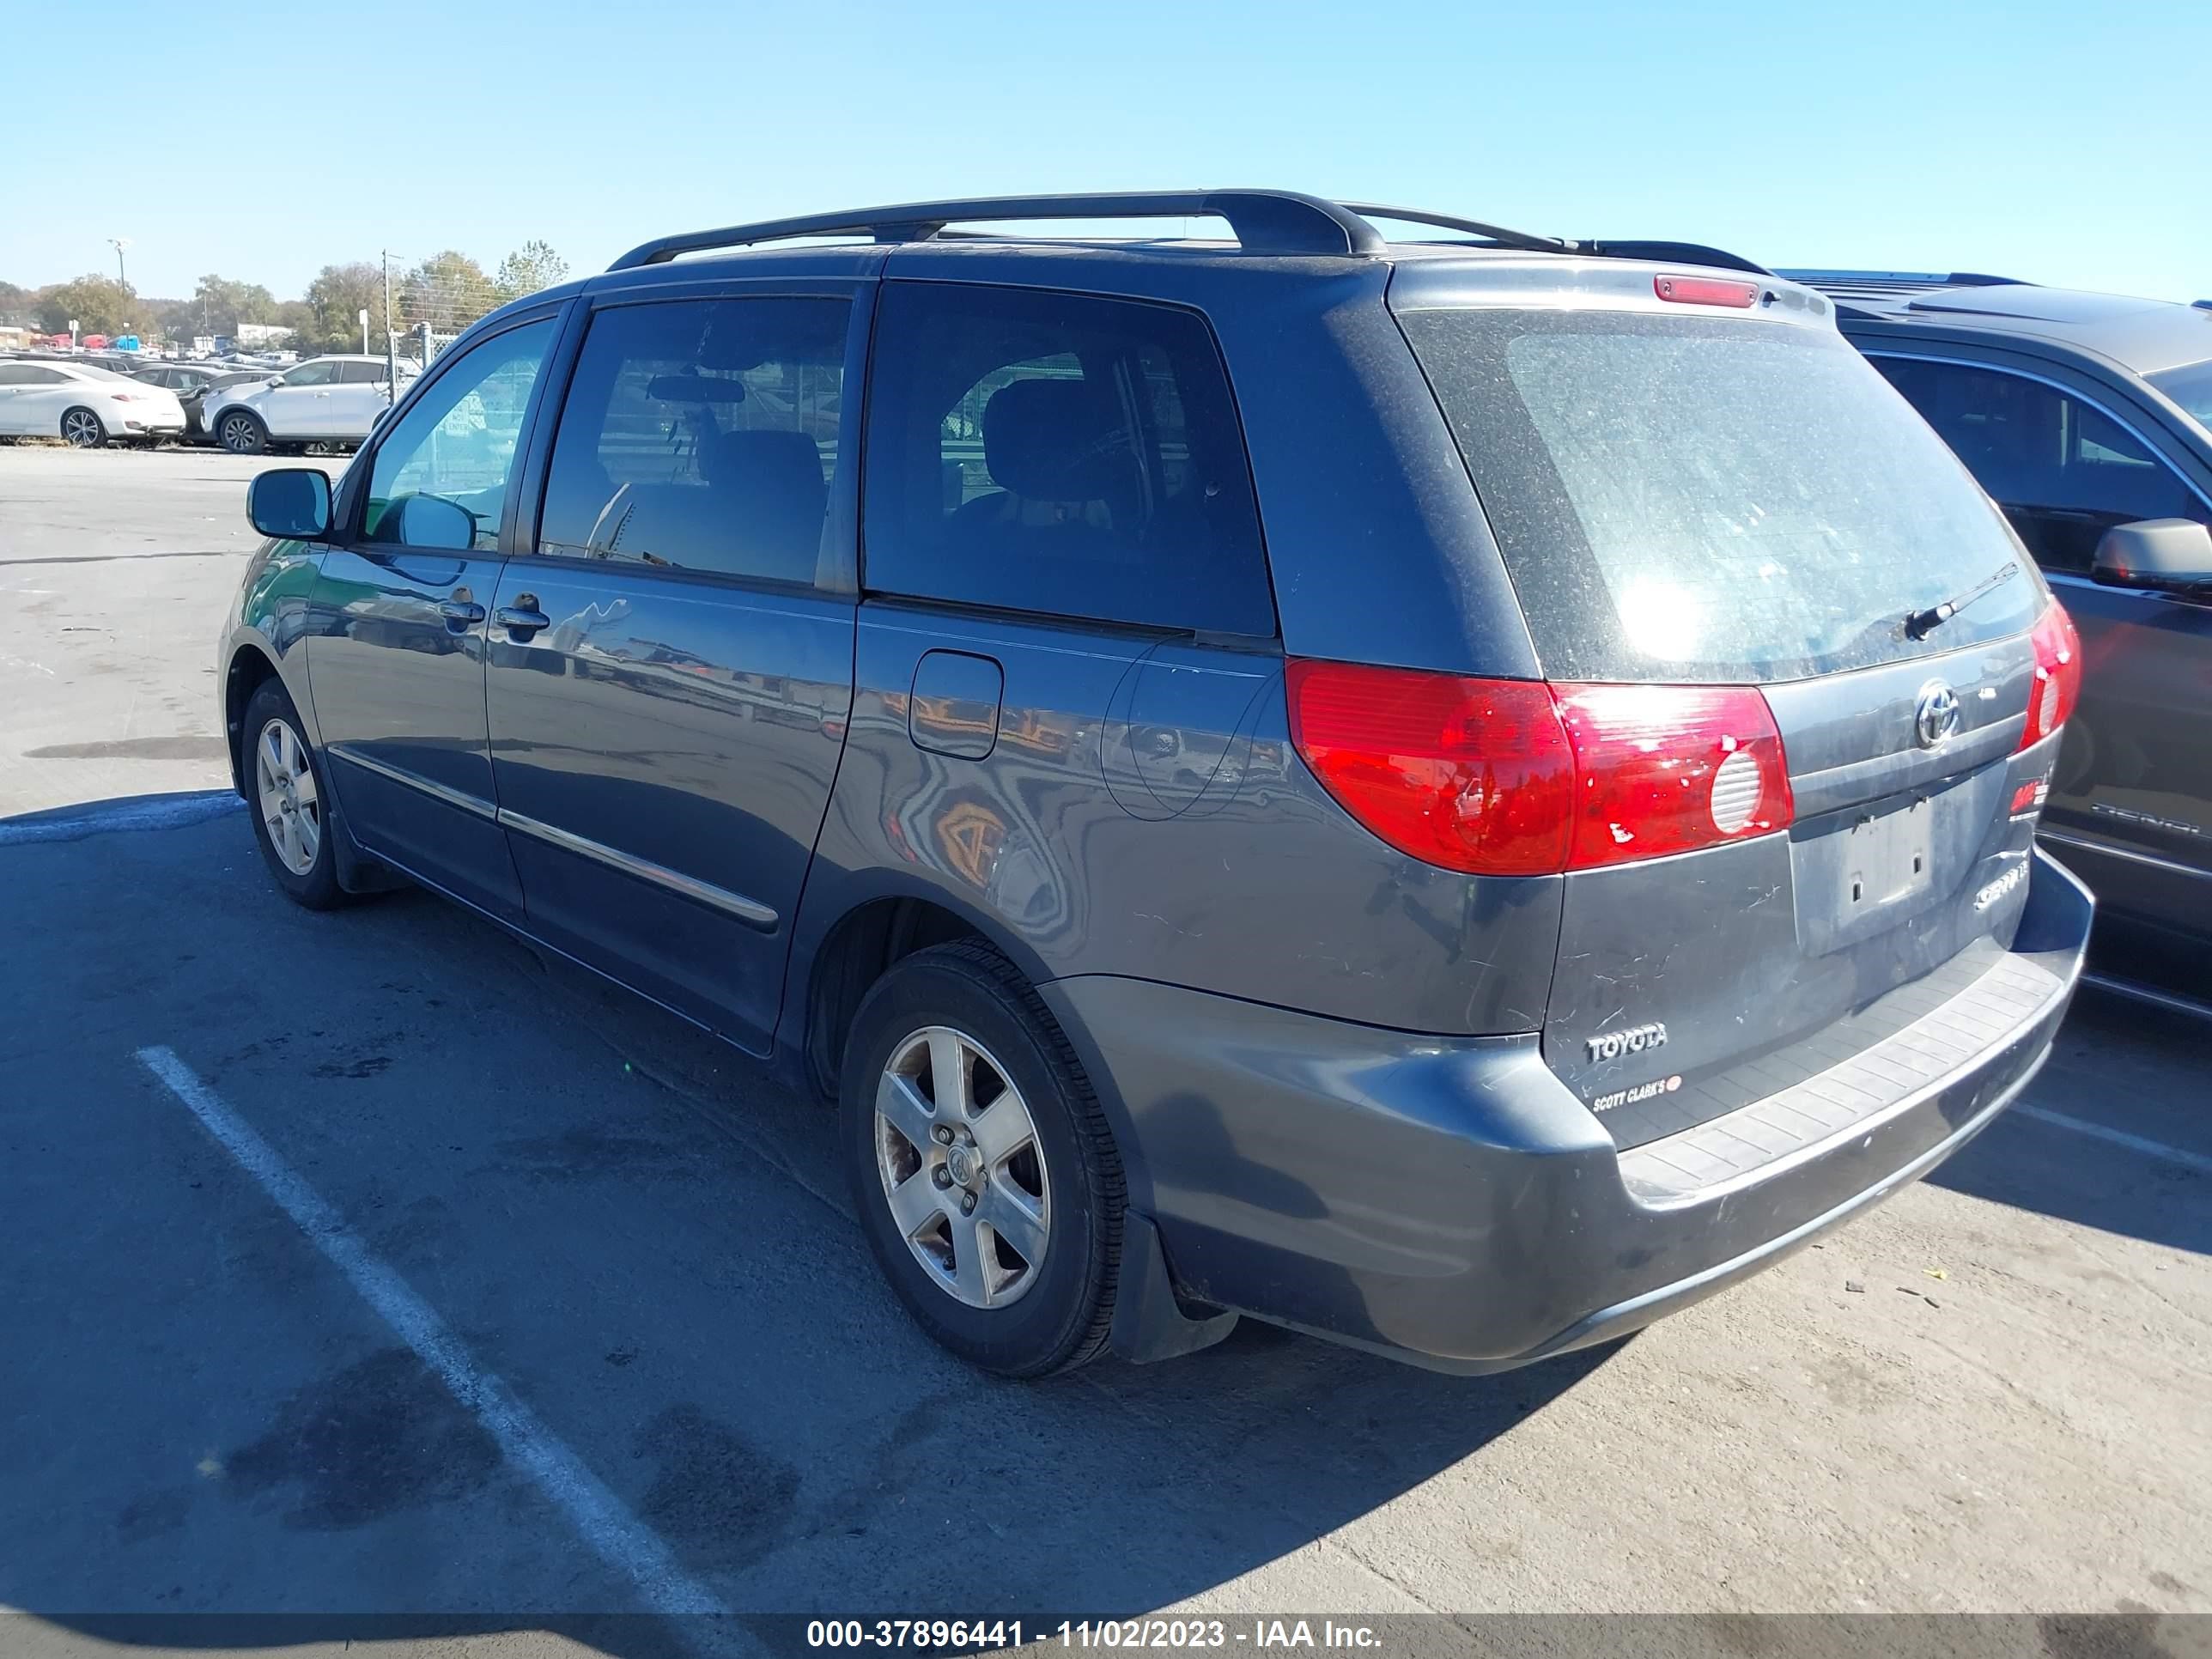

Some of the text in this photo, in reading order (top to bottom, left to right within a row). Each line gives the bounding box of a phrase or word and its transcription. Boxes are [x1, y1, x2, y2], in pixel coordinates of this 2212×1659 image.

[1587, 1022, 1668, 1063] TOYOTA
[1593, 1079, 1667, 1113] SCOTT CLARK'S
